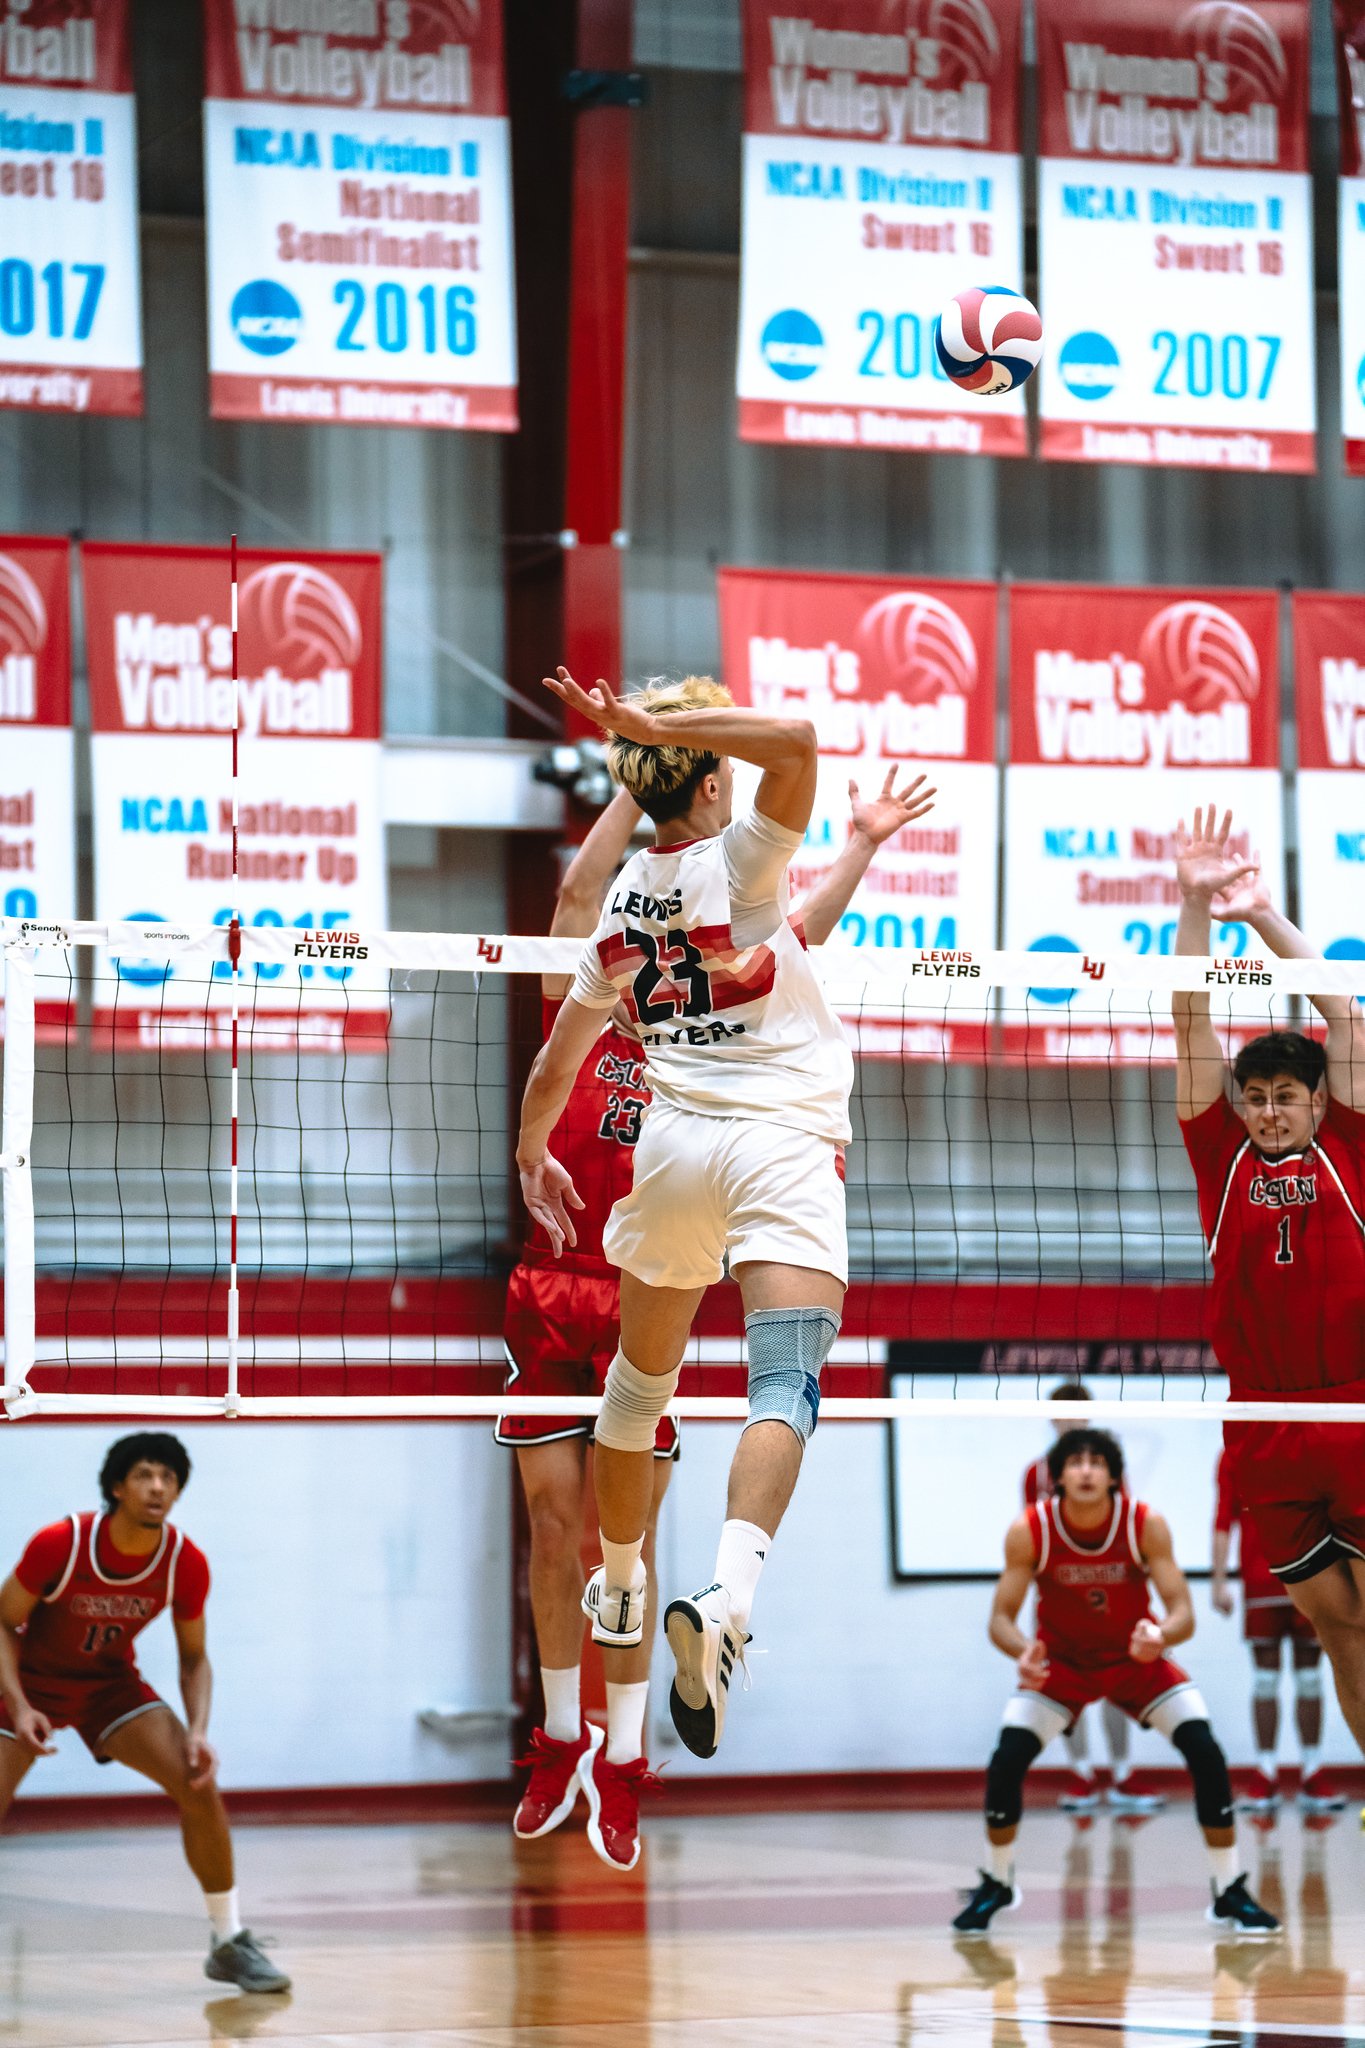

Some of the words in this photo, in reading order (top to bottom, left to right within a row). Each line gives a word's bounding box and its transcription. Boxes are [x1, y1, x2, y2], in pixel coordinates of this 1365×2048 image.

[236, 30, 471, 109] Volleyball
[770, 16, 939, 78] Women's
[1064, 42, 1228, 101] Women's
[770, 65, 988, 144] Volleyball
[234, 127, 321, 169] NCAA
[332, 132, 450, 176] Division
[1065, 91, 1279, 167] Volleyball
[339, 179, 480, 224] National
[766, 160, 845, 199] NCAA
[857, 166, 967, 208] Division
[1062, 184, 1138, 221] NCAA
[1151, 188, 1257, 229] Division
[277, 222, 480, 272] Semifinalist
[863, 213, 955, 253] Sweet
[1155, 234, 1245, 273] Sweet
[0, 258, 105, 340] 017
[332, 279, 477, 356] 2016
[857, 310, 950, 380] 20
[1152, 330, 1281, 400] 2007
[260, 381, 334, 416] Lewis
[339, 384, 468, 427] University
[784, 405, 856, 442] Lewis
[859, 410, 983, 454] University
[1082, 424, 1150, 459] Lewis
[1153, 428, 1271, 471] University
[115, 613, 233, 669] Men's
[748, 636, 860, 694] Men's
[117, 663, 353, 738] Volleyball
[1034, 649, 1144, 705] Men's
[1035, 699, 1251, 768] Volleyball
[121, 797, 208, 833] NCAA
[218, 797, 357, 836] National
[186, 842, 306, 880] Runner
[317, 845, 357, 886] Up
[1043, 828, 1120, 859] NCAA
[31, 924, 61, 932] Senoh
[144, 932, 164, 940] sports
[165, 933, 190, 941] imports
[294, 944, 368, 959] FLYERS
[303, 931, 360, 944] LEWIS
[477, 937, 502, 964] LU
[625, 927, 713, 1026] 23
[912, 963, 981, 978] FLYERS
[921, 950, 972, 963] LEWIS
[1082, 956, 1105, 981] LU
[1205, 971, 1273, 986] FLYERS
[1214, 959, 1264, 970] LEWIS
[139, 1009, 211, 1047] Lewis
[598, 1091, 648, 1146] 23
[1275, 1214, 1294, 1264] 1
